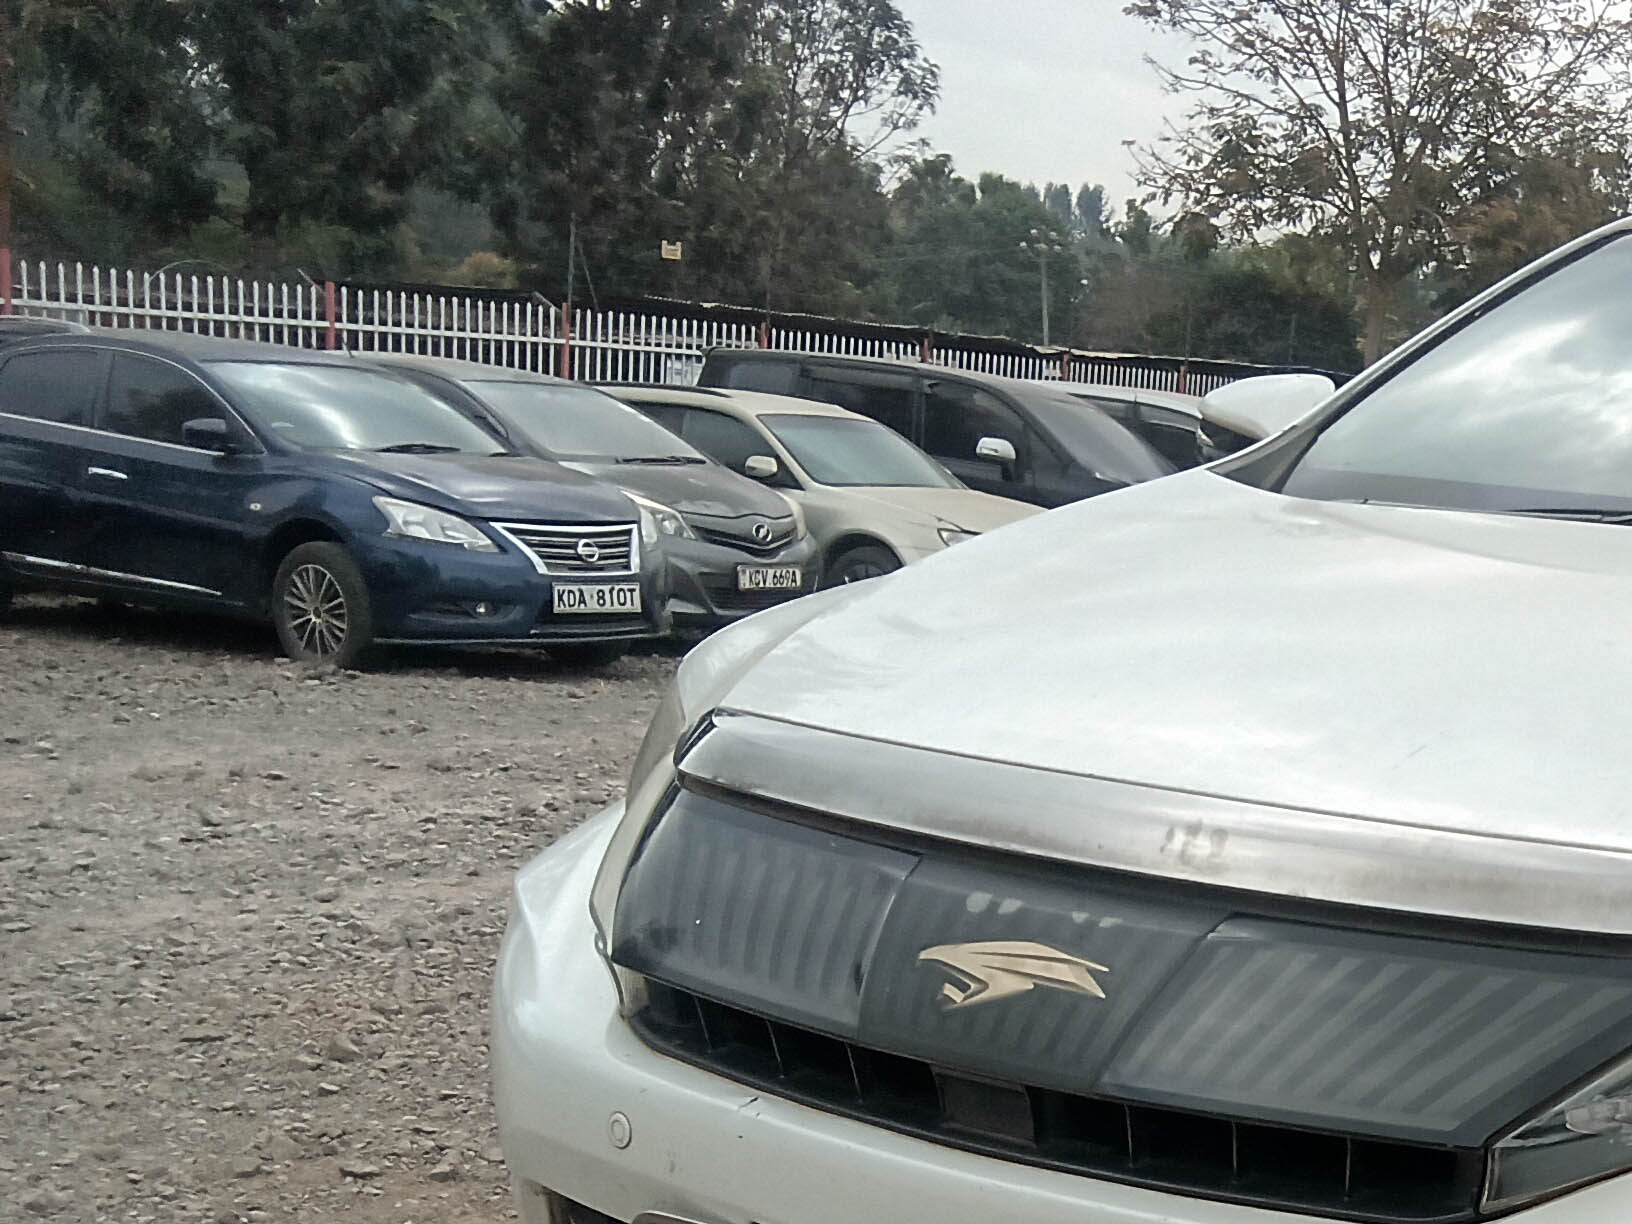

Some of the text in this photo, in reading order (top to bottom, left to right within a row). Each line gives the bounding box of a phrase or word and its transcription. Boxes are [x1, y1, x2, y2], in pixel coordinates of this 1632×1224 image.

[772, 569, 798, 587] 669A
[557, 586, 637, 608] KDA 810T
